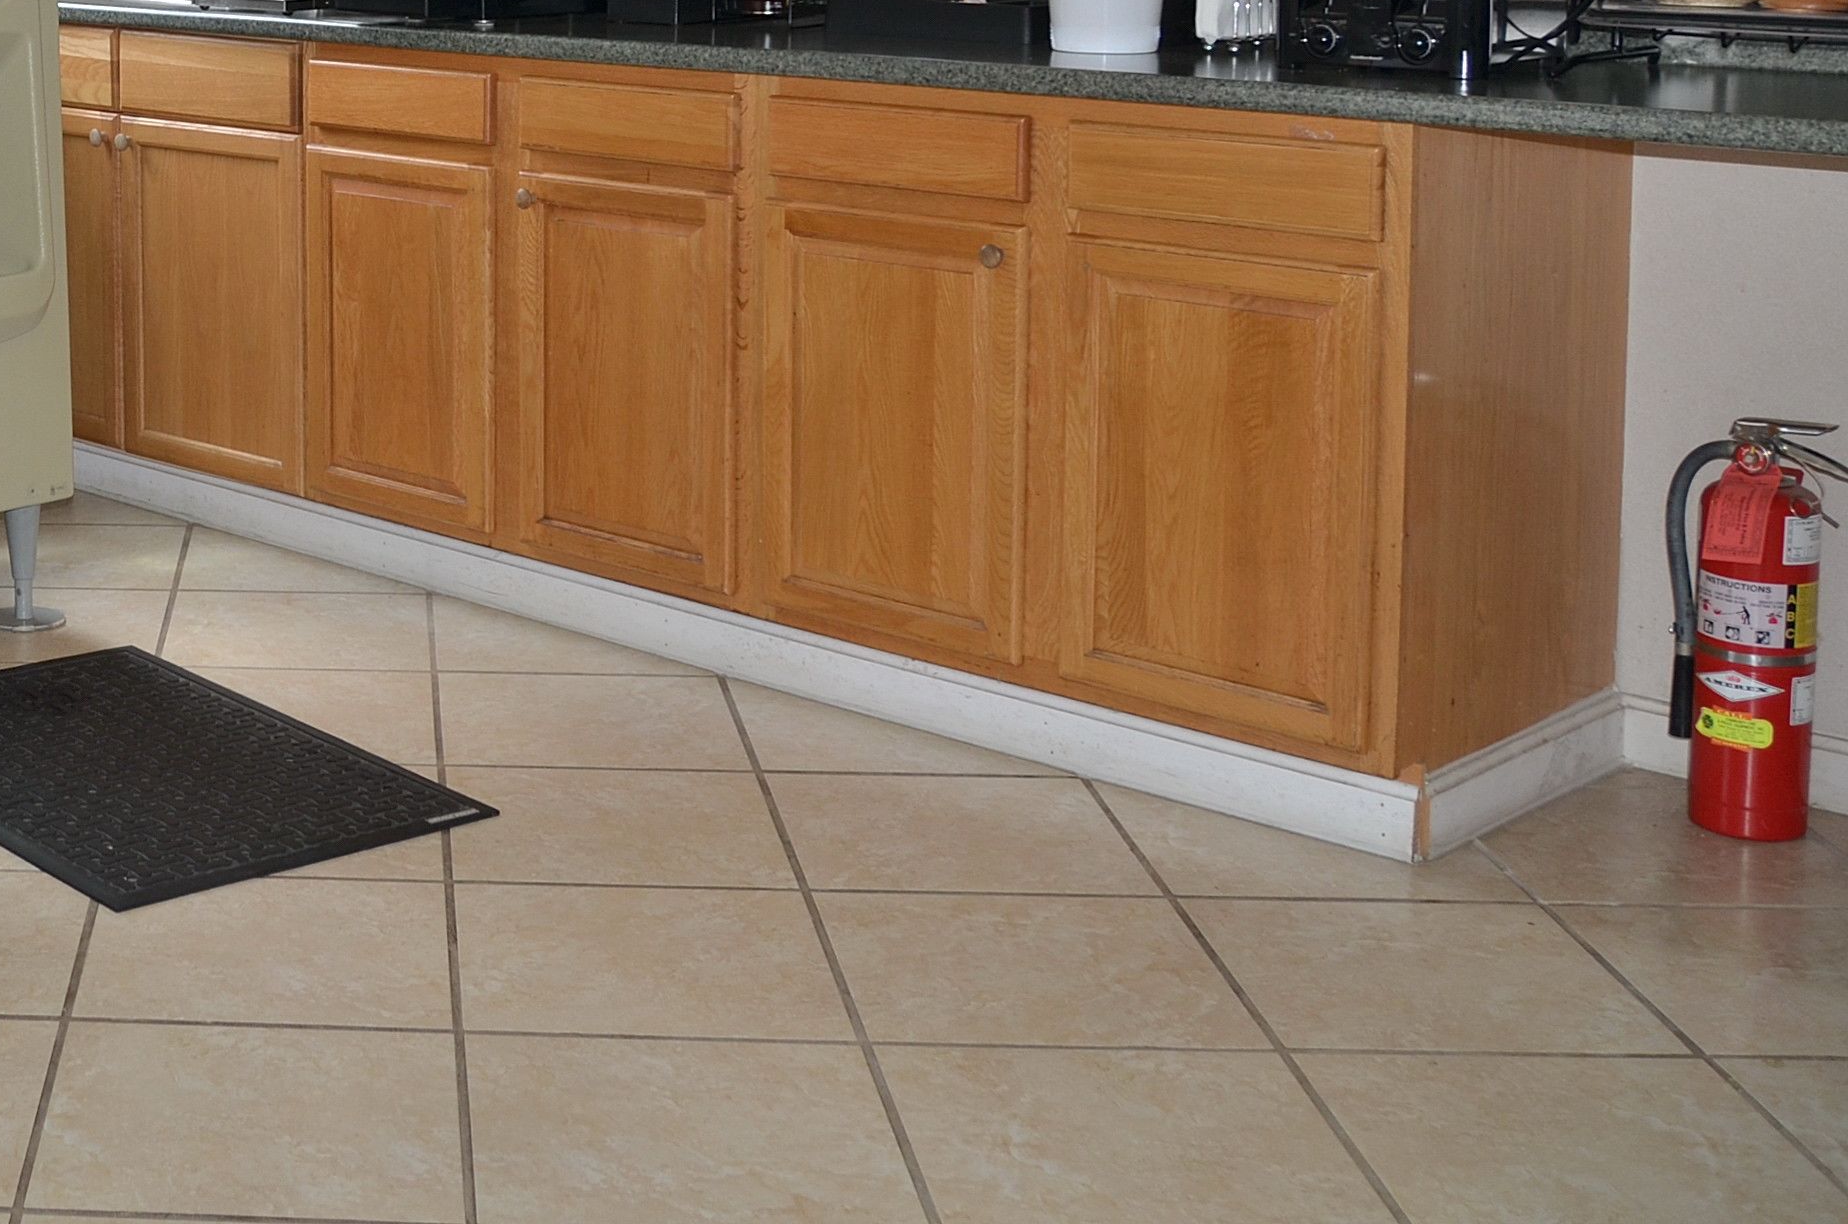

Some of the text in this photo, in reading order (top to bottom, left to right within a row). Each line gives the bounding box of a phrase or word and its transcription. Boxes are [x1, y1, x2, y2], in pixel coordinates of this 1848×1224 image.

[1787, 594, 1797, 605] A
[1786, 612, 1796, 623] B
[1785, 628, 1795, 640] C
[1705, 676, 1768, 693] AMEREX
